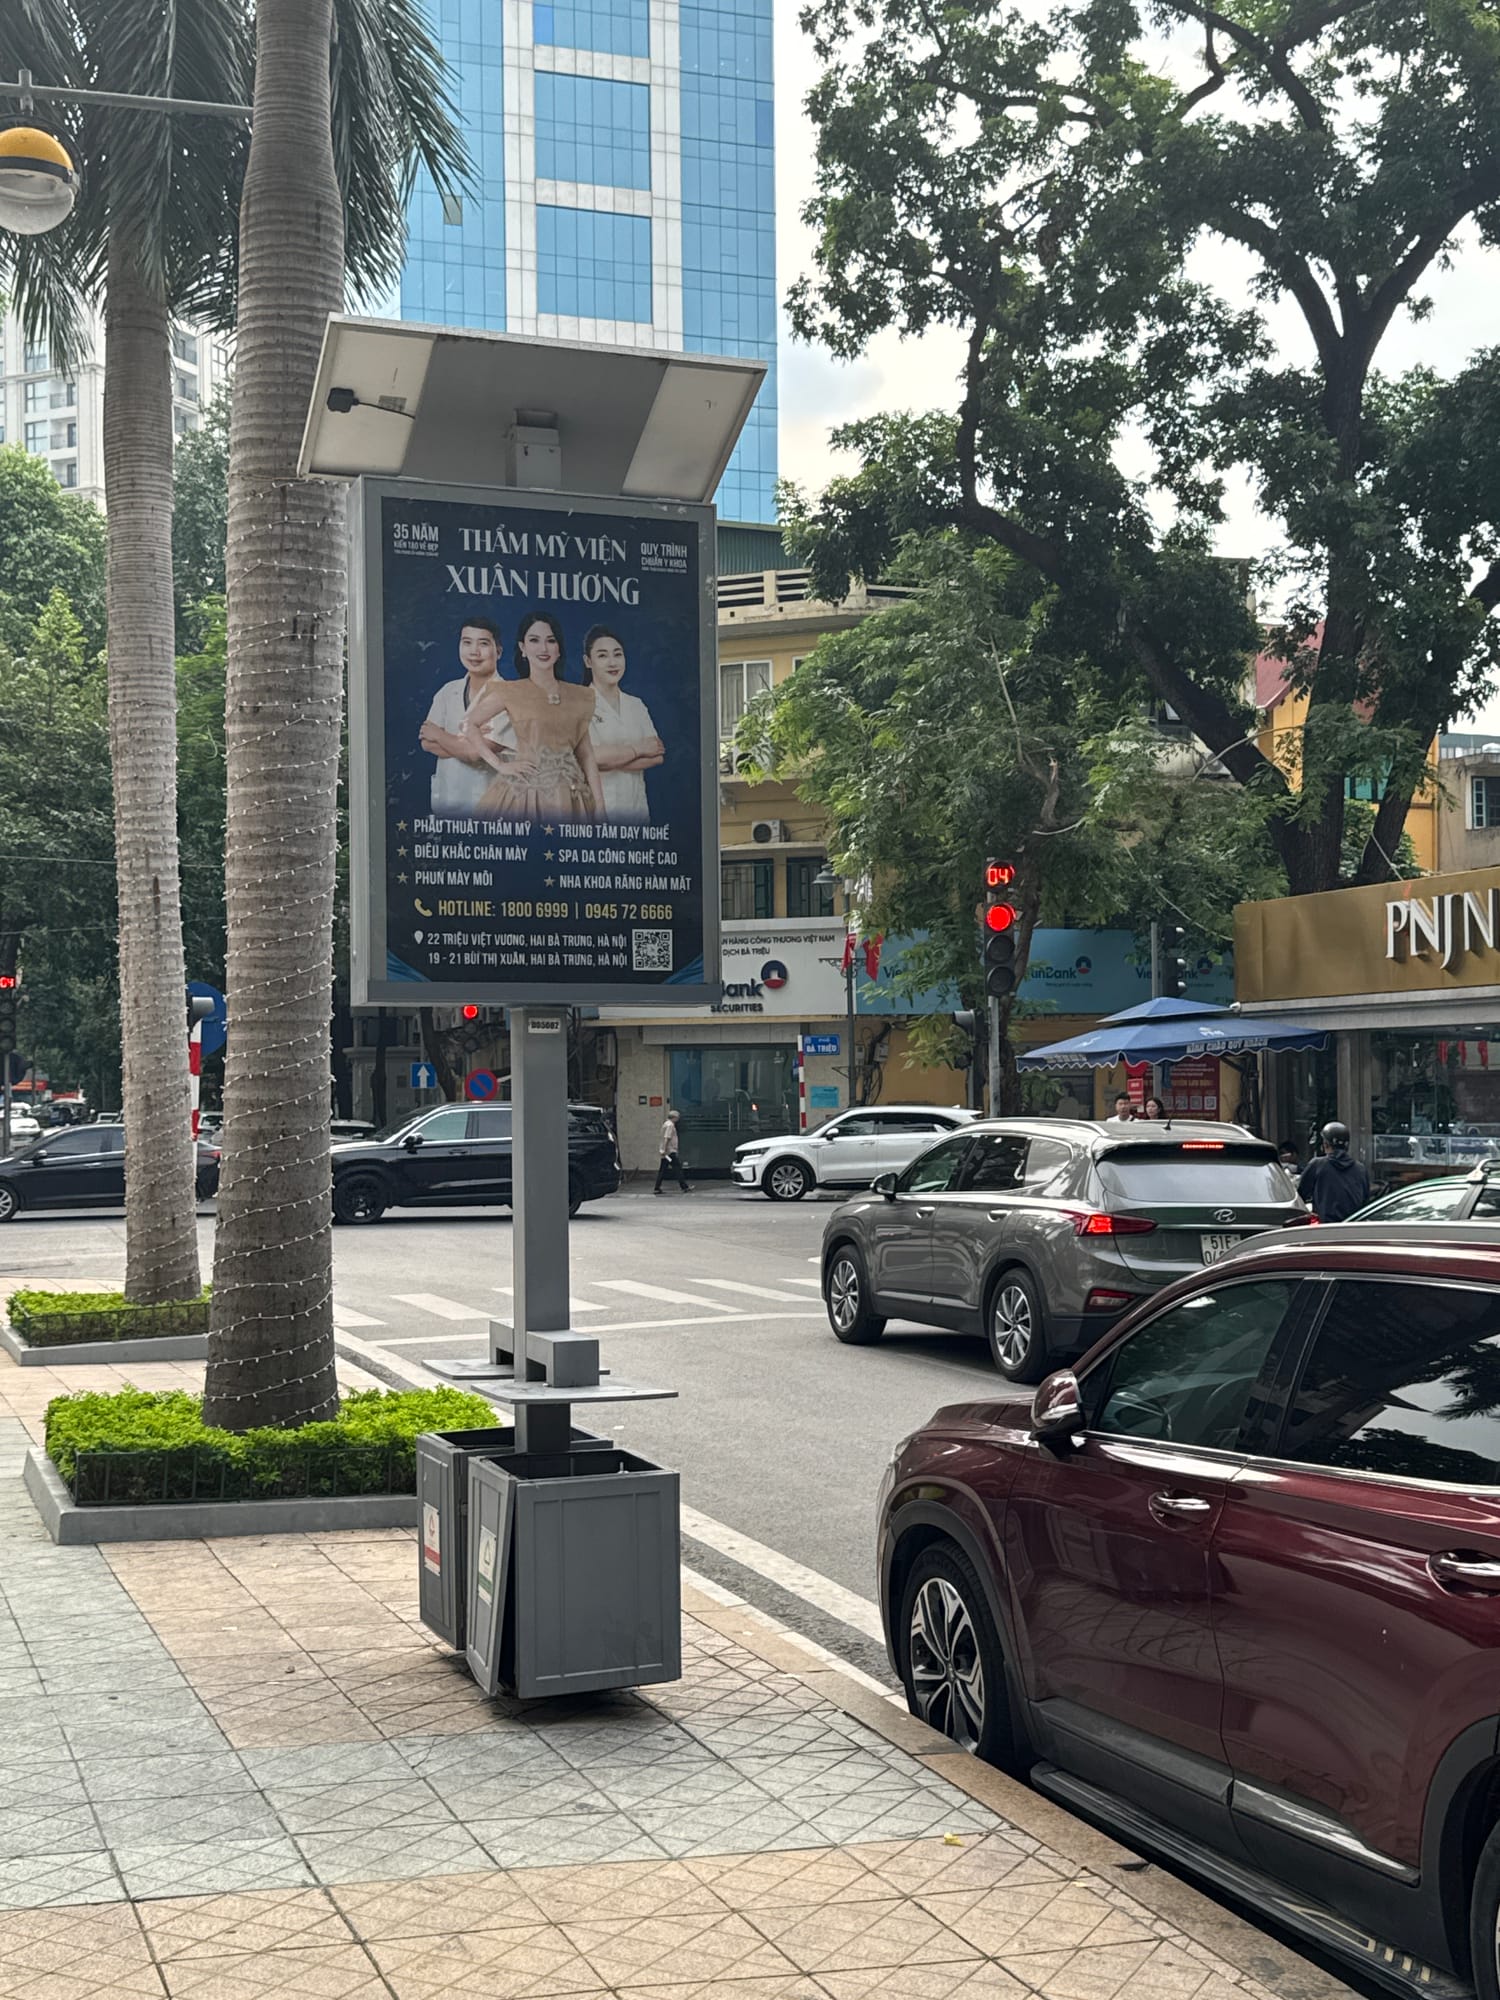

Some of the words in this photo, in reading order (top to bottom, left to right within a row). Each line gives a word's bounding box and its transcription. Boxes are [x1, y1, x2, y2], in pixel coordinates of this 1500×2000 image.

[393, 523, 409, 540] 35
[412, 521, 439, 542] NĂM
[458, 523, 528, 556] THẨM
[535, 531, 570, 558] MỸ
[574, 534, 627, 566] VIỆN
[640, 542, 659, 556] QUY
[660, 542, 688, 558] TRÌNH
[445, 562, 529, 598] XUÂN
[537, 571, 640, 606] HƯƠNG
[445, 818, 480, 837] THUẬT
[482, 816, 512, 836] THẨM
[515, 820, 532, 836] MỸ
[558, 823, 593, 839] TRUNG
[595, 822, 618, 839] TÂM
[620, 825, 640, 842] DẠY
[442, 840, 471, 860] KHẮC
[473, 843, 503, 861] CHÂN
[505, 844, 528, 862] MÀY
[558, 848, 579, 863] SPA
[581, 850, 596, 864] DA
[598, 847, 626, 864] CÔNG
[628, 848, 655, 868] NGHỆ
[657, 851, 678, 866] CAO
[415, 870, 445, 886] PHUN
[447, 868, 471, 886] MÀY
[473, 870, 493, 887] MÔI
[559, 874, 581, 889] NHA
[584, 875, 612, 889] KHOA
[615, 873, 643, 890] RĂNG
[645, 874, 668, 891] HÀM
[670, 875, 692, 894] MẶT
[987, 867, 1009, 887] 04
[438, 900, 496, 917] HOTLINE:
[501, 901, 532, 918] 1800
[535, 902, 569, 919] 6999
[585, 903, 618, 919] 0945
[621, 904, 637, 920] 72
[640, 904, 673, 920] 6666
[427, 933, 440, 945] 22
[442, 930, 469, 948] TRIỆU
[471, 931, 492, 948] VIỆT
[530, 934, 546, 946] HAI
[547, 932, 561, 947] BÀ
[597, 933, 610, 948] HÀ
[612, 933, 627, 950] NỘI
[428, 951, 440, 965] 19
[449, 952, 461, 965] 21
[482, 952, 498, 968] THỊ
[530, 953, 546, 966] HAI
[547, 952, 561, 966] BÀ
[597, 953, 610, 967] HÀ
[612, 953, 628, 969] NỘI
